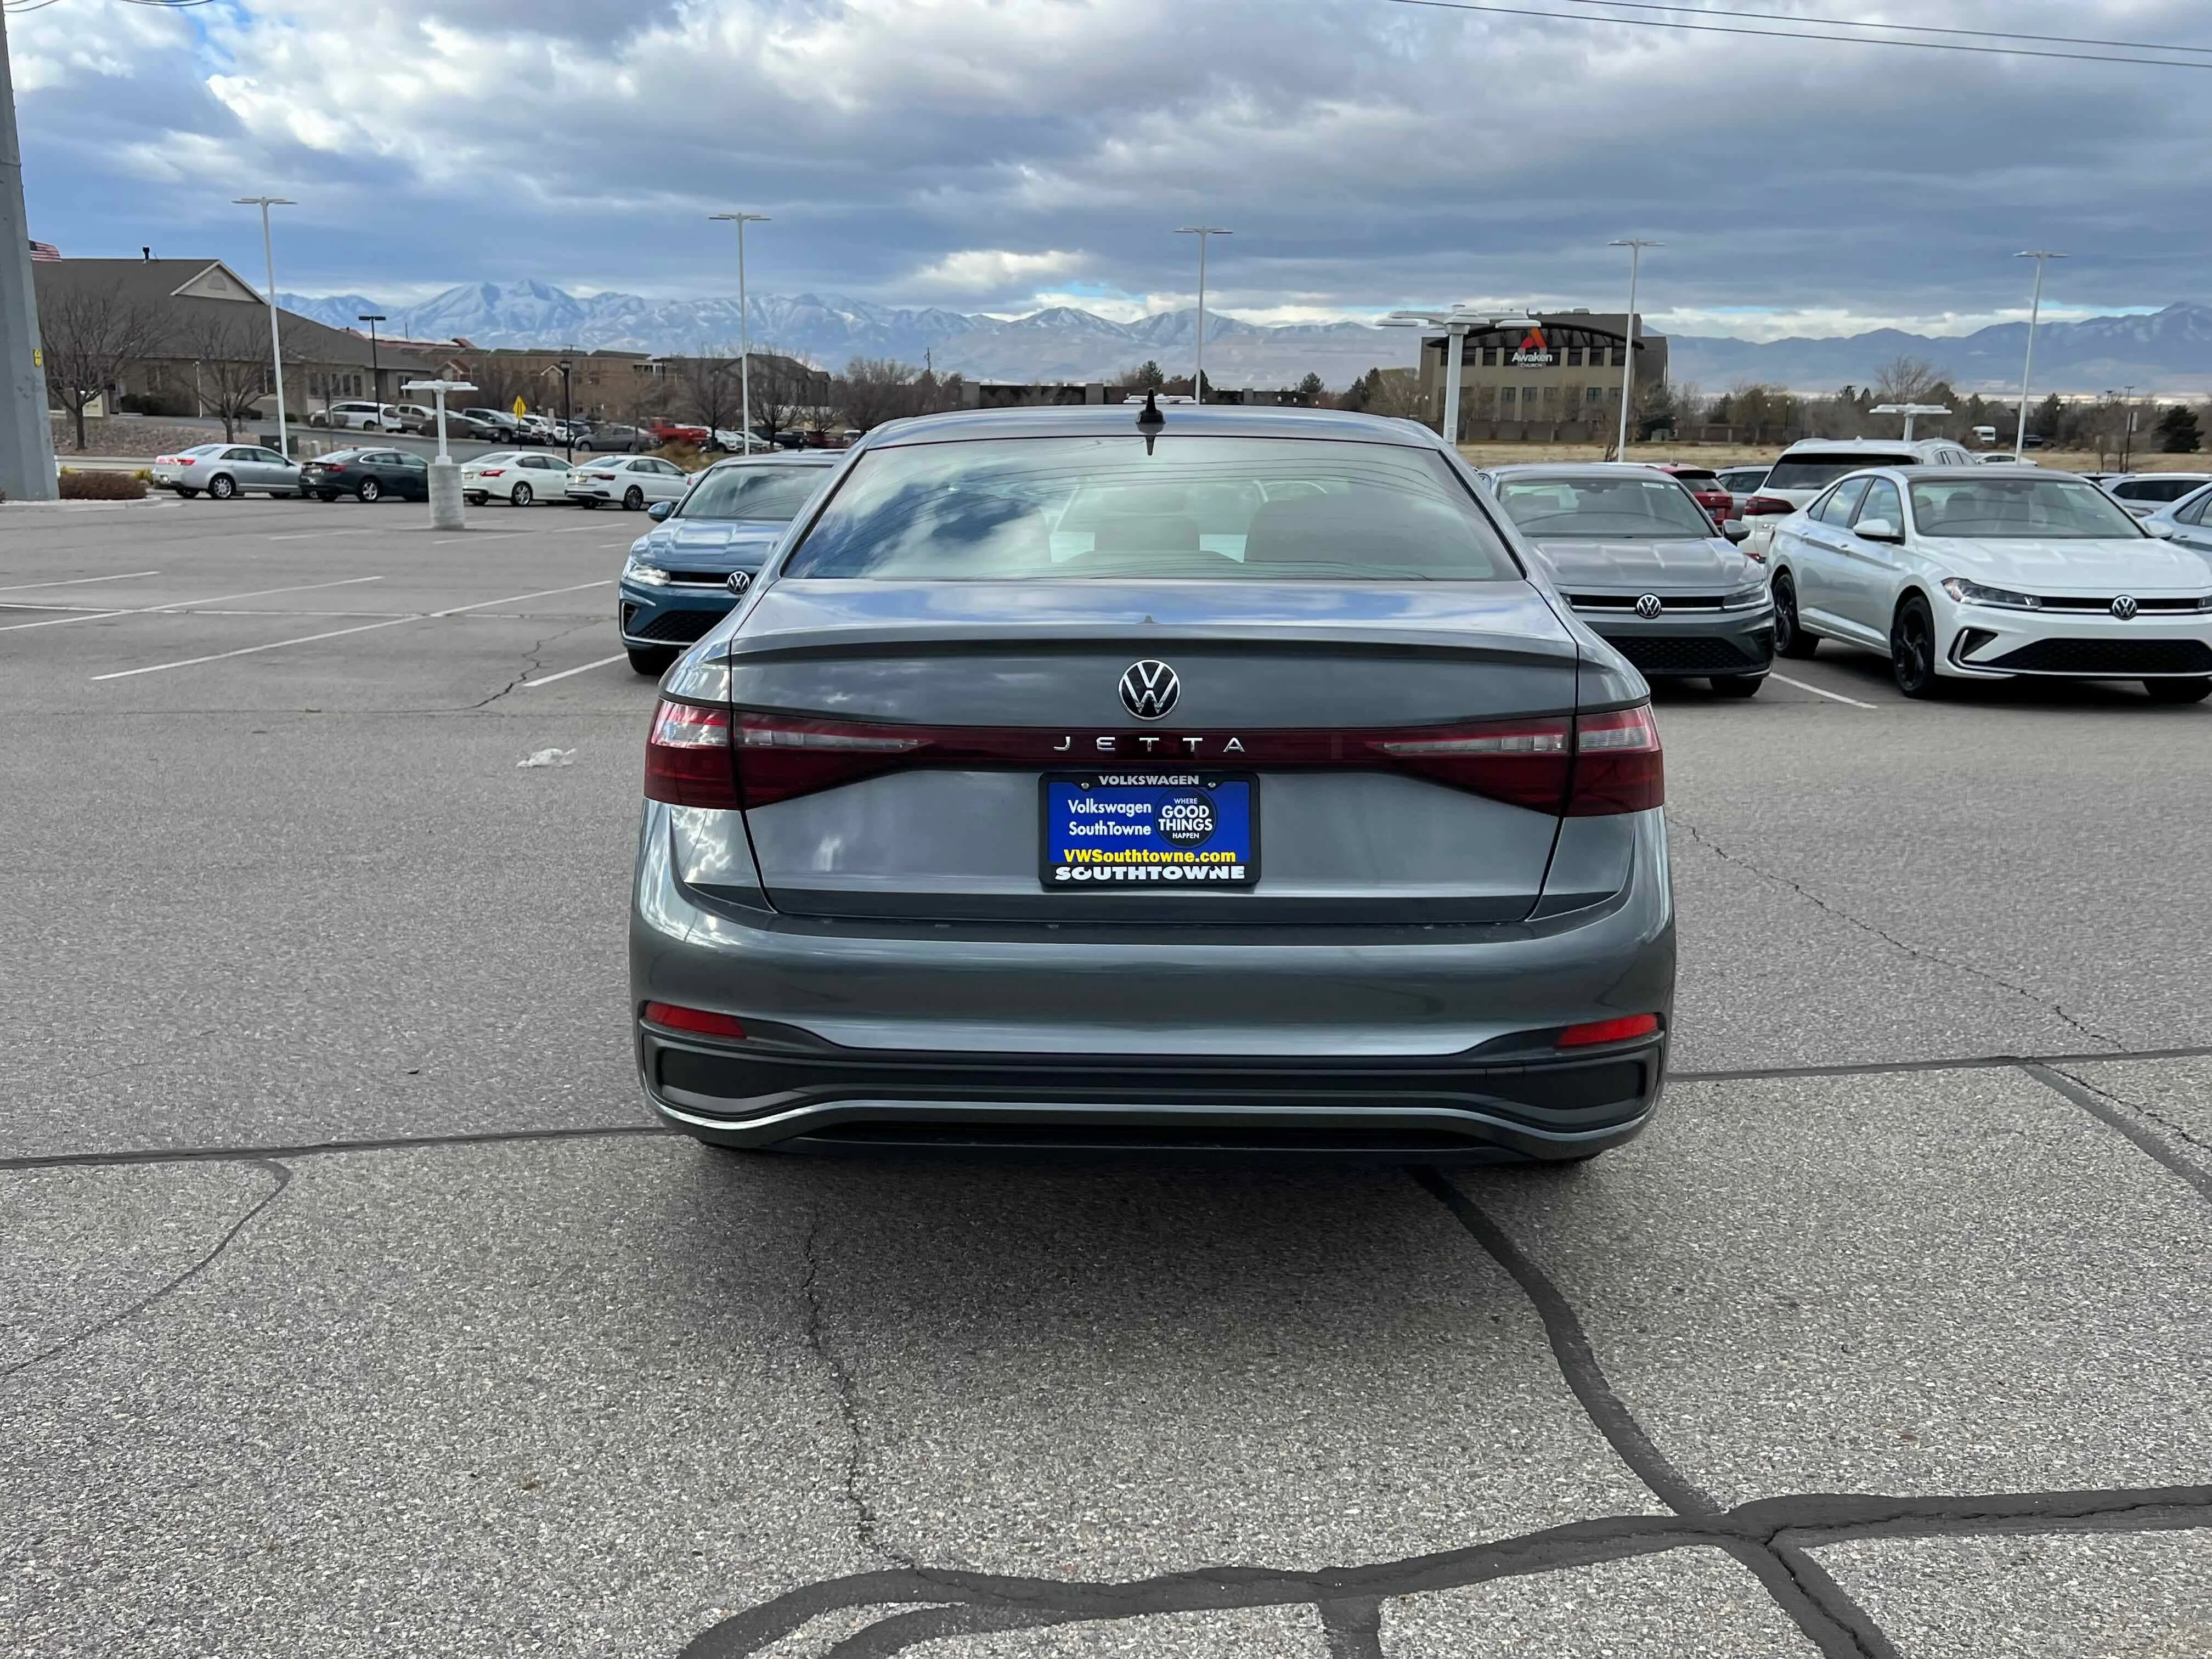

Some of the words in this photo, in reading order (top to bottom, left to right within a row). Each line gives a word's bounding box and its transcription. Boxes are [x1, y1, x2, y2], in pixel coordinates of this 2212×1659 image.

[1511, 352, 1553, 362] Awaken
[1053, 736, 1245, 753] JETTA
[1099, 775, 1199, 785] VOLKSWAGEN
[1068, 798, 1152, 817] Volkswagen
[1161, 805, 1210, 819] GOOD
[1068, 821, 1152, 836] SouthTowne
[1158, 818, 1213, 832] THINGS
[1064, 849, 1236, 863] VWSouthtowne.com
[1055, 866, 1245, 881] SOUTHTOWNE
